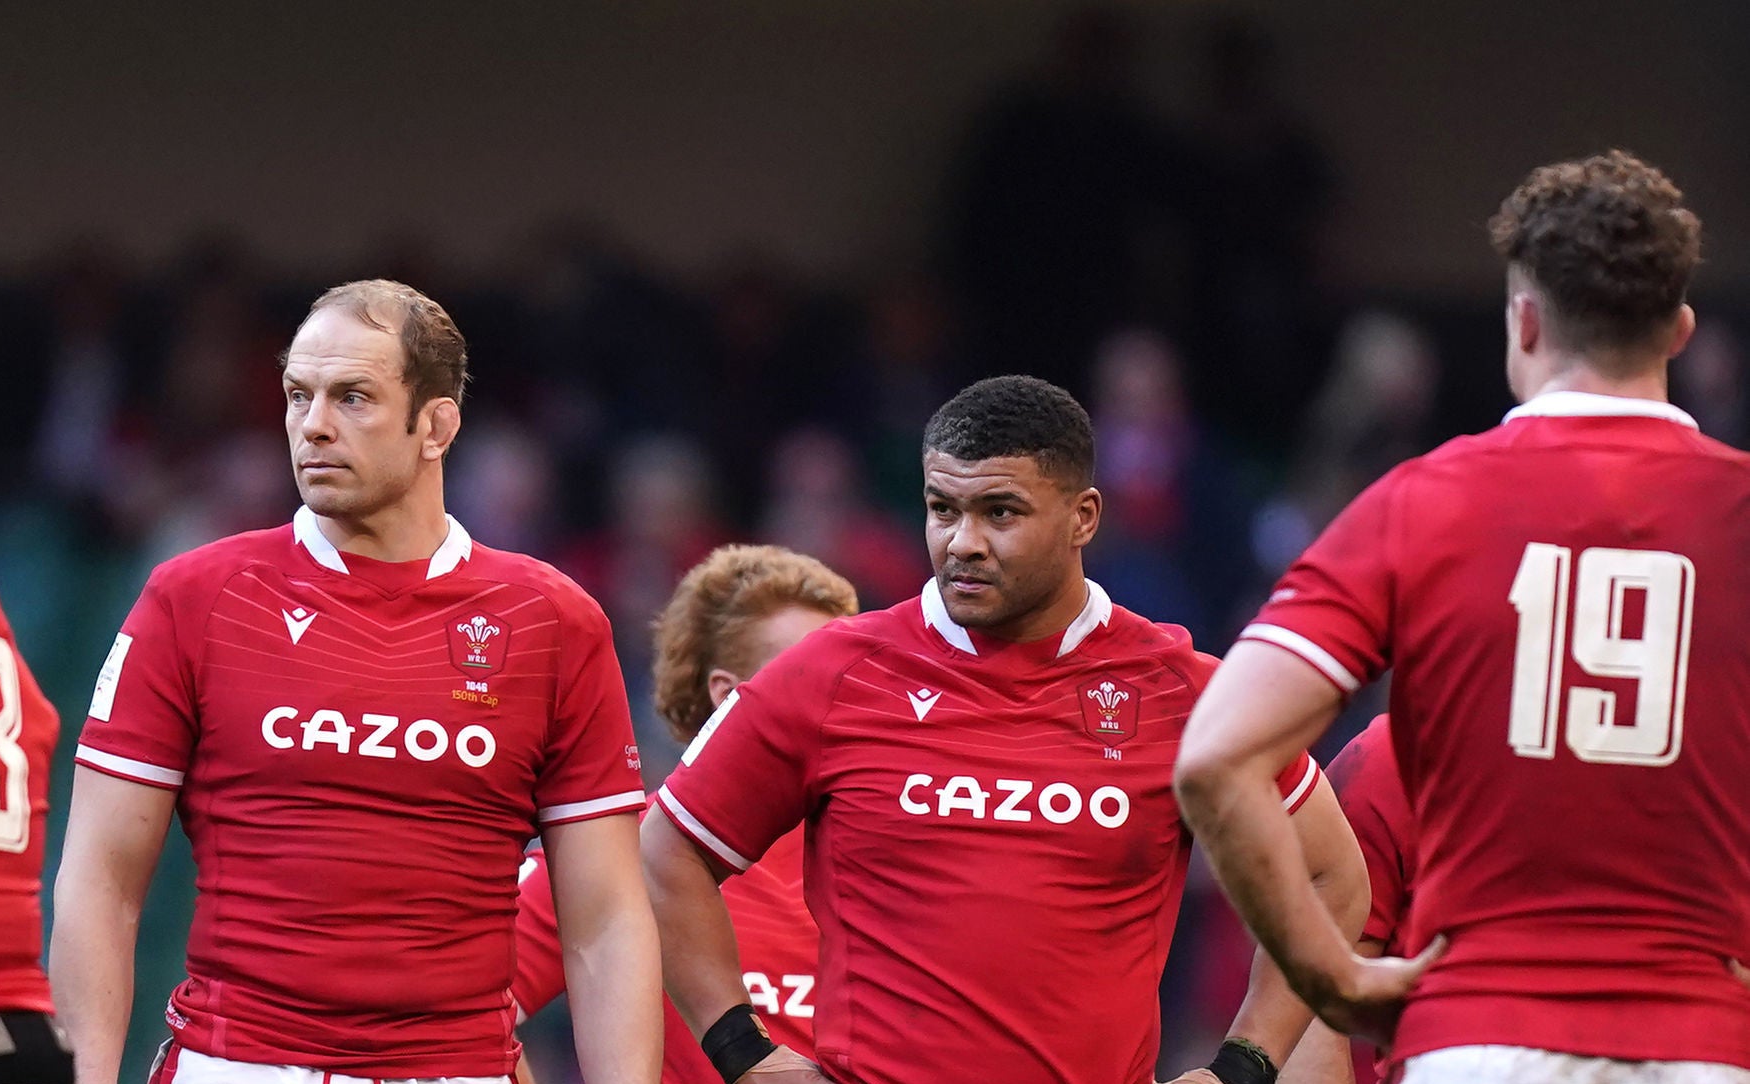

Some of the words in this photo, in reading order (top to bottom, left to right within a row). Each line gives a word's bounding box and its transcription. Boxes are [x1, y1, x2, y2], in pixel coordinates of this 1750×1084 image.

[467, 654, 487, 663] WRU
[1507, 541, 1696, 767] 19
[465, 681, 488, 693] 1046
[452, 690, 478, 702] 150th
[480, 694, 499, 708] Cap
[1100, 721, 1119, 730] WRU
[260, 705, 497, 769] CAZOO
[1103, 747, 1122, 761] 1141
[898, 772, 1131, 830] CAZOO
